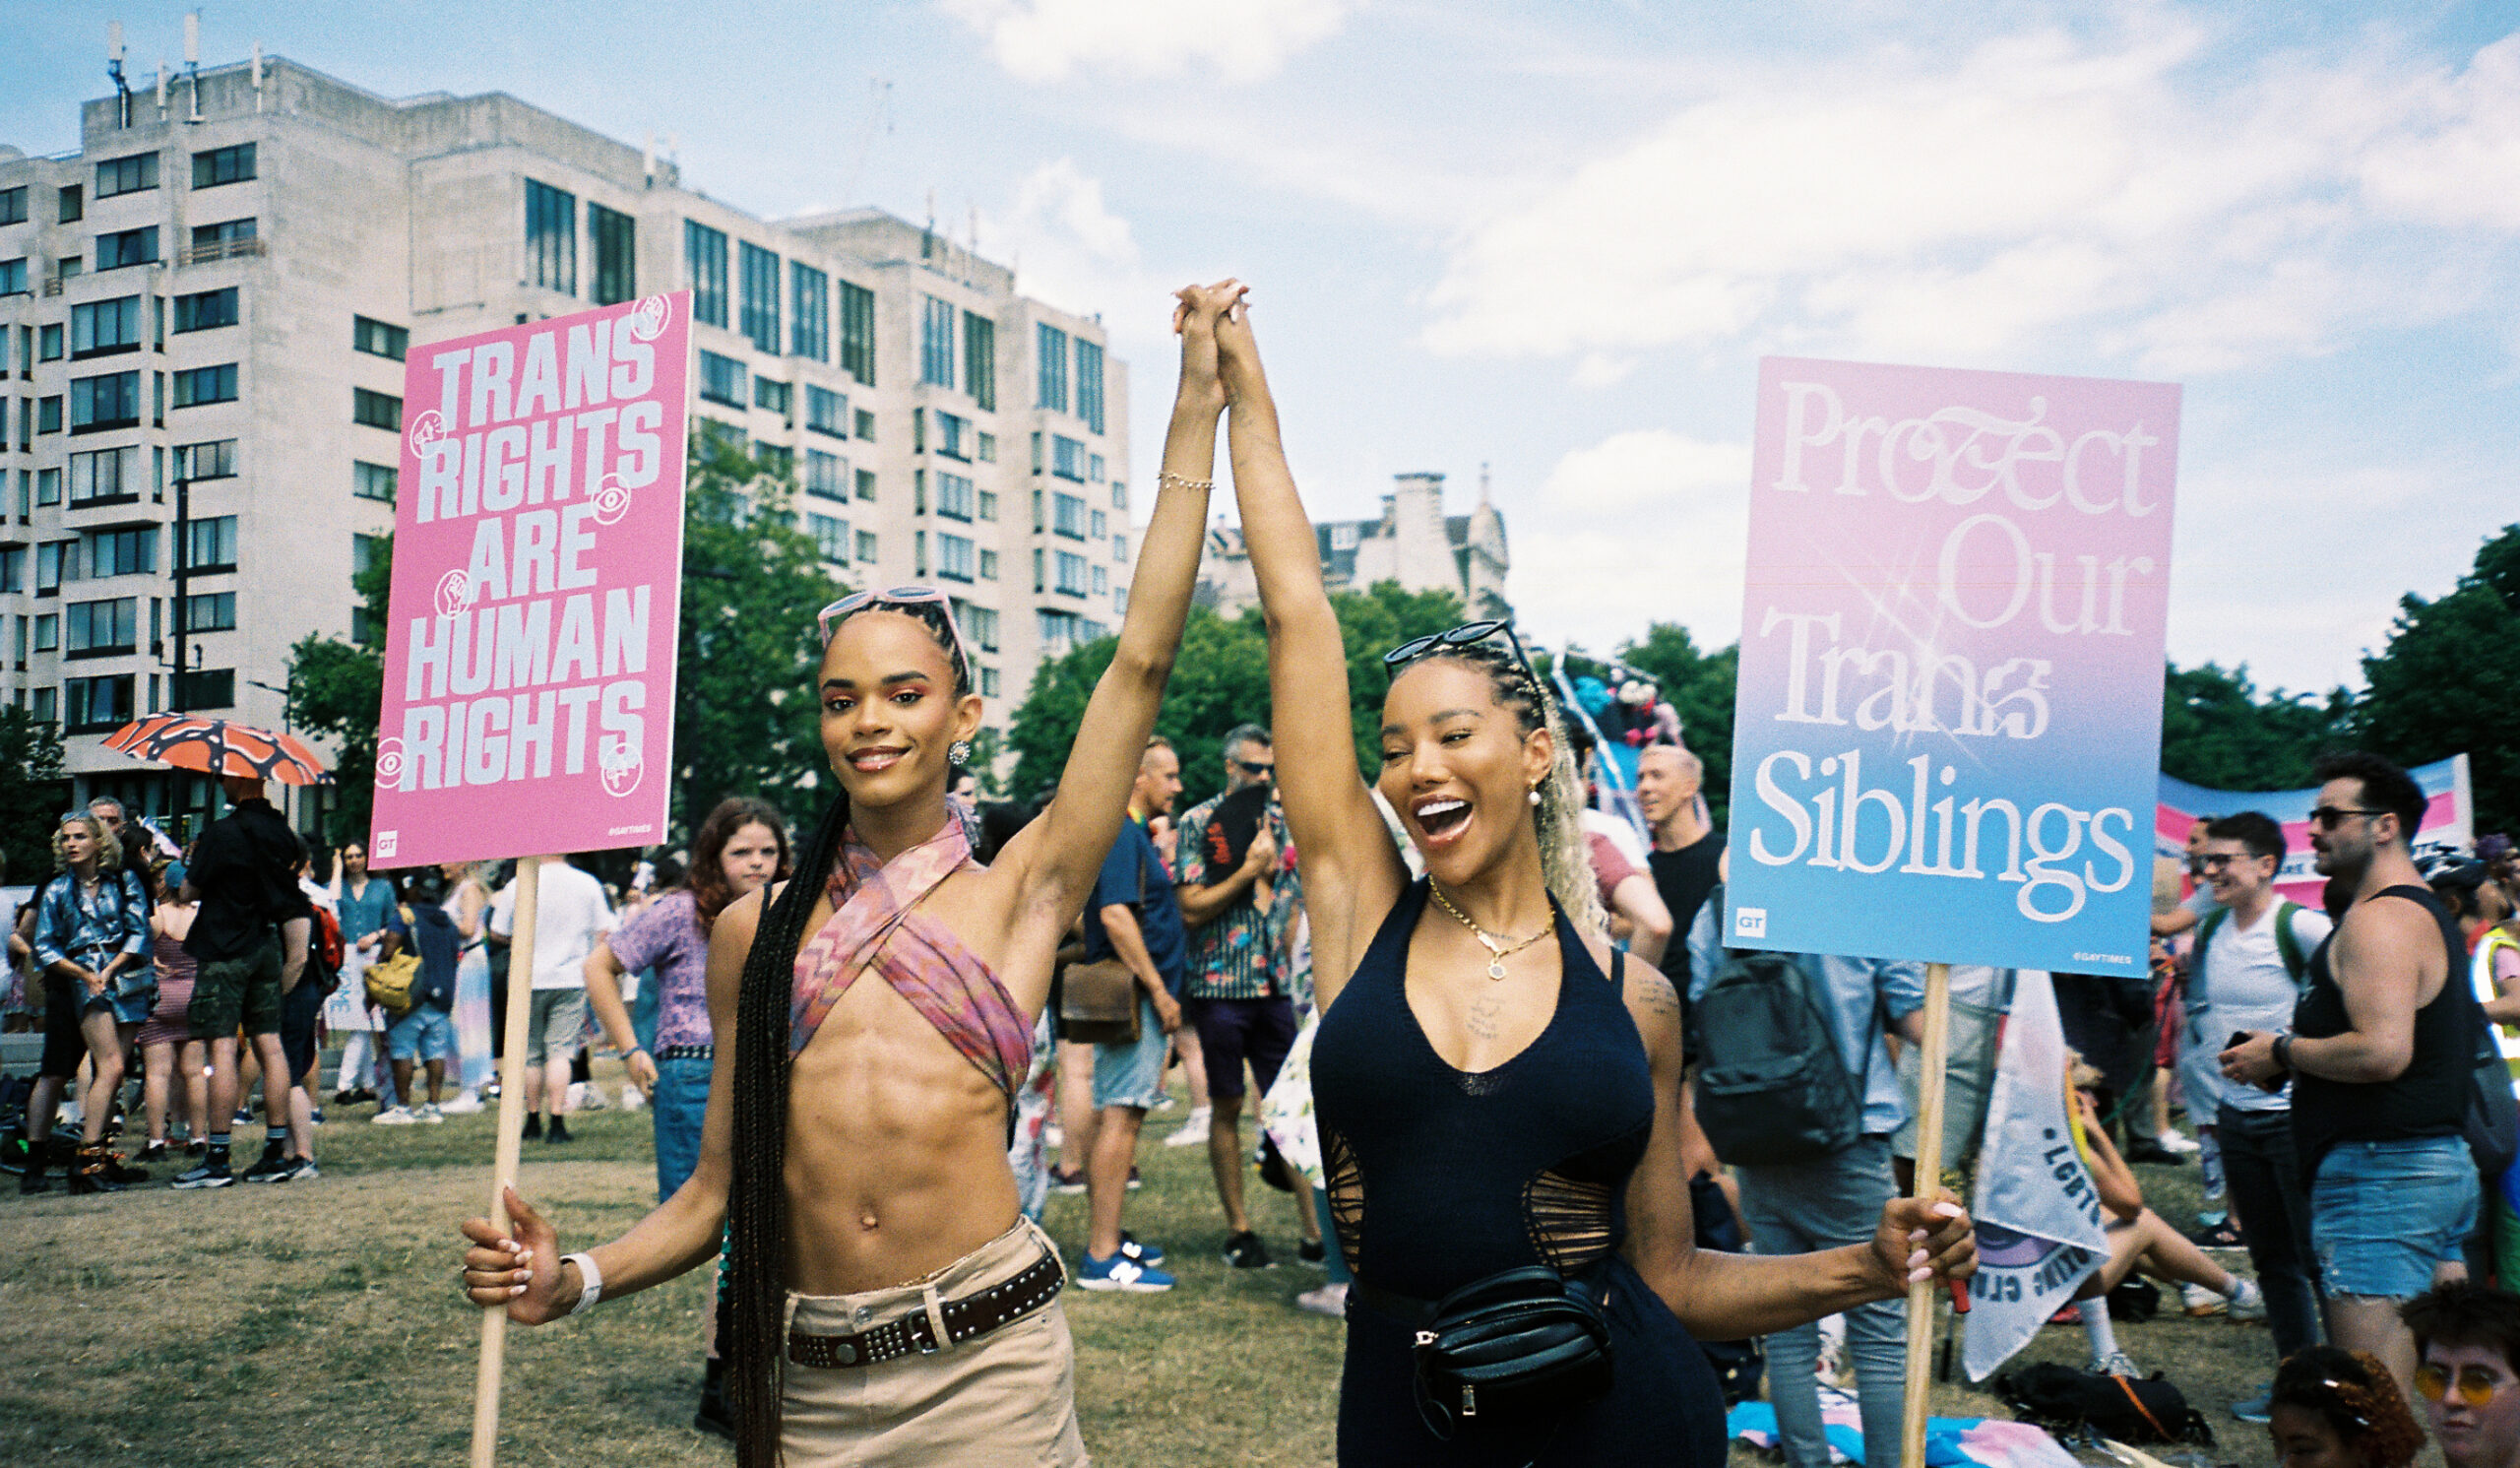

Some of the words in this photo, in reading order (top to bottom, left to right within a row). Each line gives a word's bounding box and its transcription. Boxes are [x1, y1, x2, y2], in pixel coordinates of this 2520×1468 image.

[432, 313, 656, 430] TRANS
[416, 401, 662, 524] RIGHTS
[1773, 380, 2160, 517] Protect
[470, 501, 599, 604] ARE
[1938, 513, 2156, 636] Our
[405, 584, 651, 701] HUMAN
[1759, 605, 2052, 740] Trans
[398, 679, 647, 793] RIGHTS
[379, 838, 395, 850] GT
[1749, 748, 2134, 923] Siblings
[1739, 916, 1764, 928] GT
